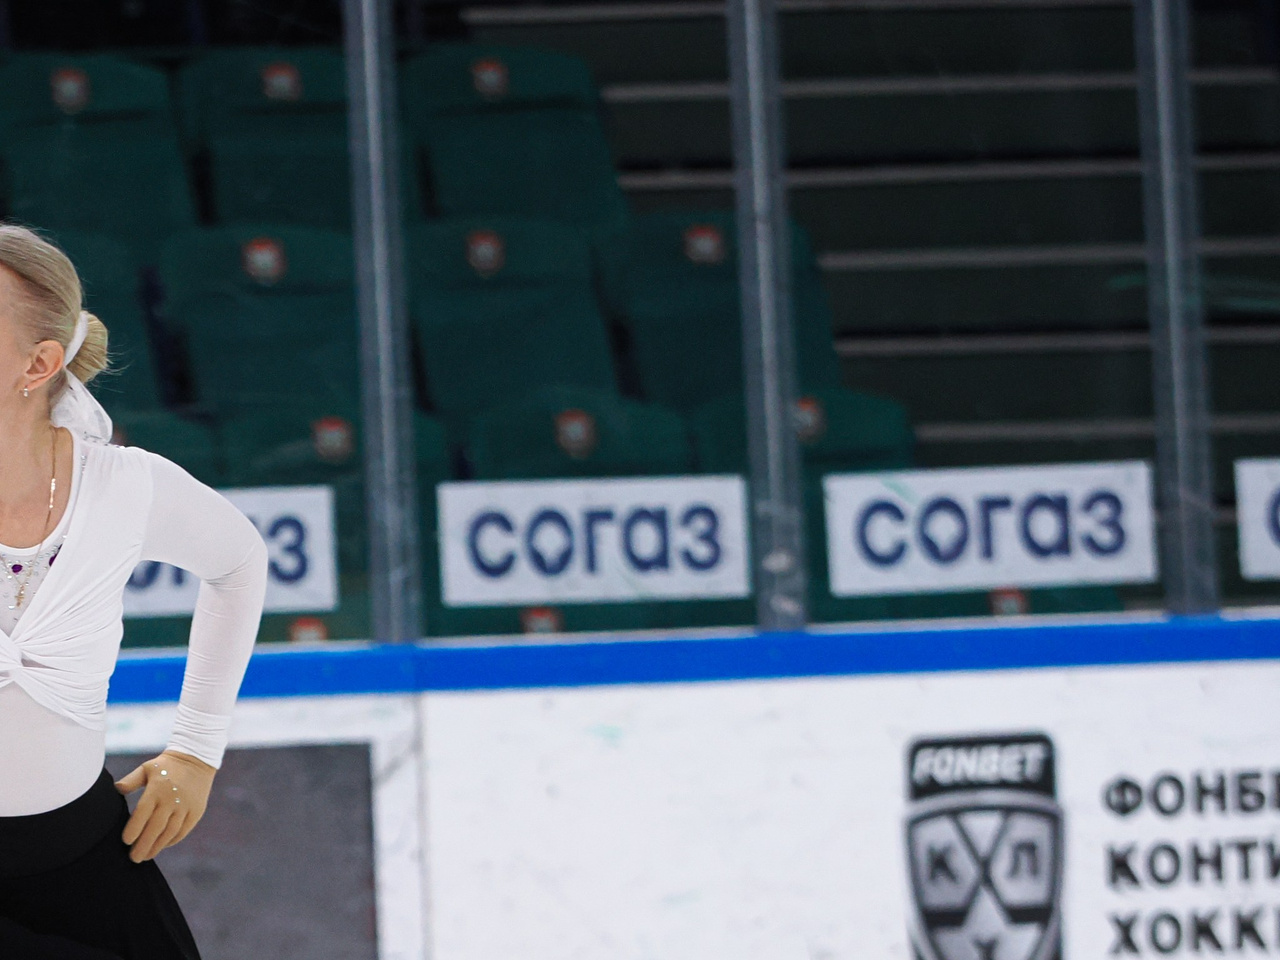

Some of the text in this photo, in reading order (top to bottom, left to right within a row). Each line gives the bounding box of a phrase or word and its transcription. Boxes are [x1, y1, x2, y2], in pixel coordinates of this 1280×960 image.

[912, 741, 1045, 785] FONBET
[1104, 770, 1280, 818] ФОНБ
[1106, 908, 1280, 955] ХОКК
